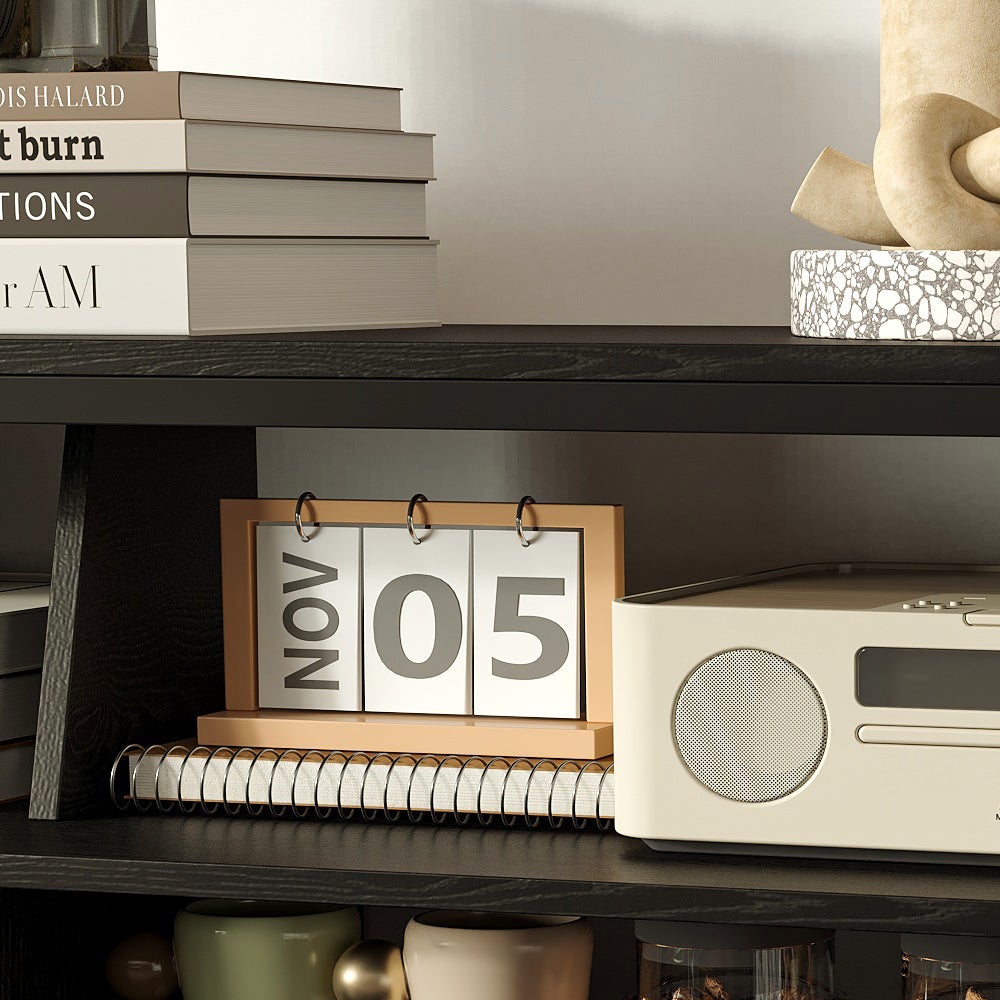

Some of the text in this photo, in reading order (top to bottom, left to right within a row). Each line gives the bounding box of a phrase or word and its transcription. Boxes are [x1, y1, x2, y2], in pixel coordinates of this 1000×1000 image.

[34, 85, 125, 107] HALARD
[17, 126, 105, 161] burn
[25, 264, 101, 309] AM
[282, 551, 340, 691] NOV
